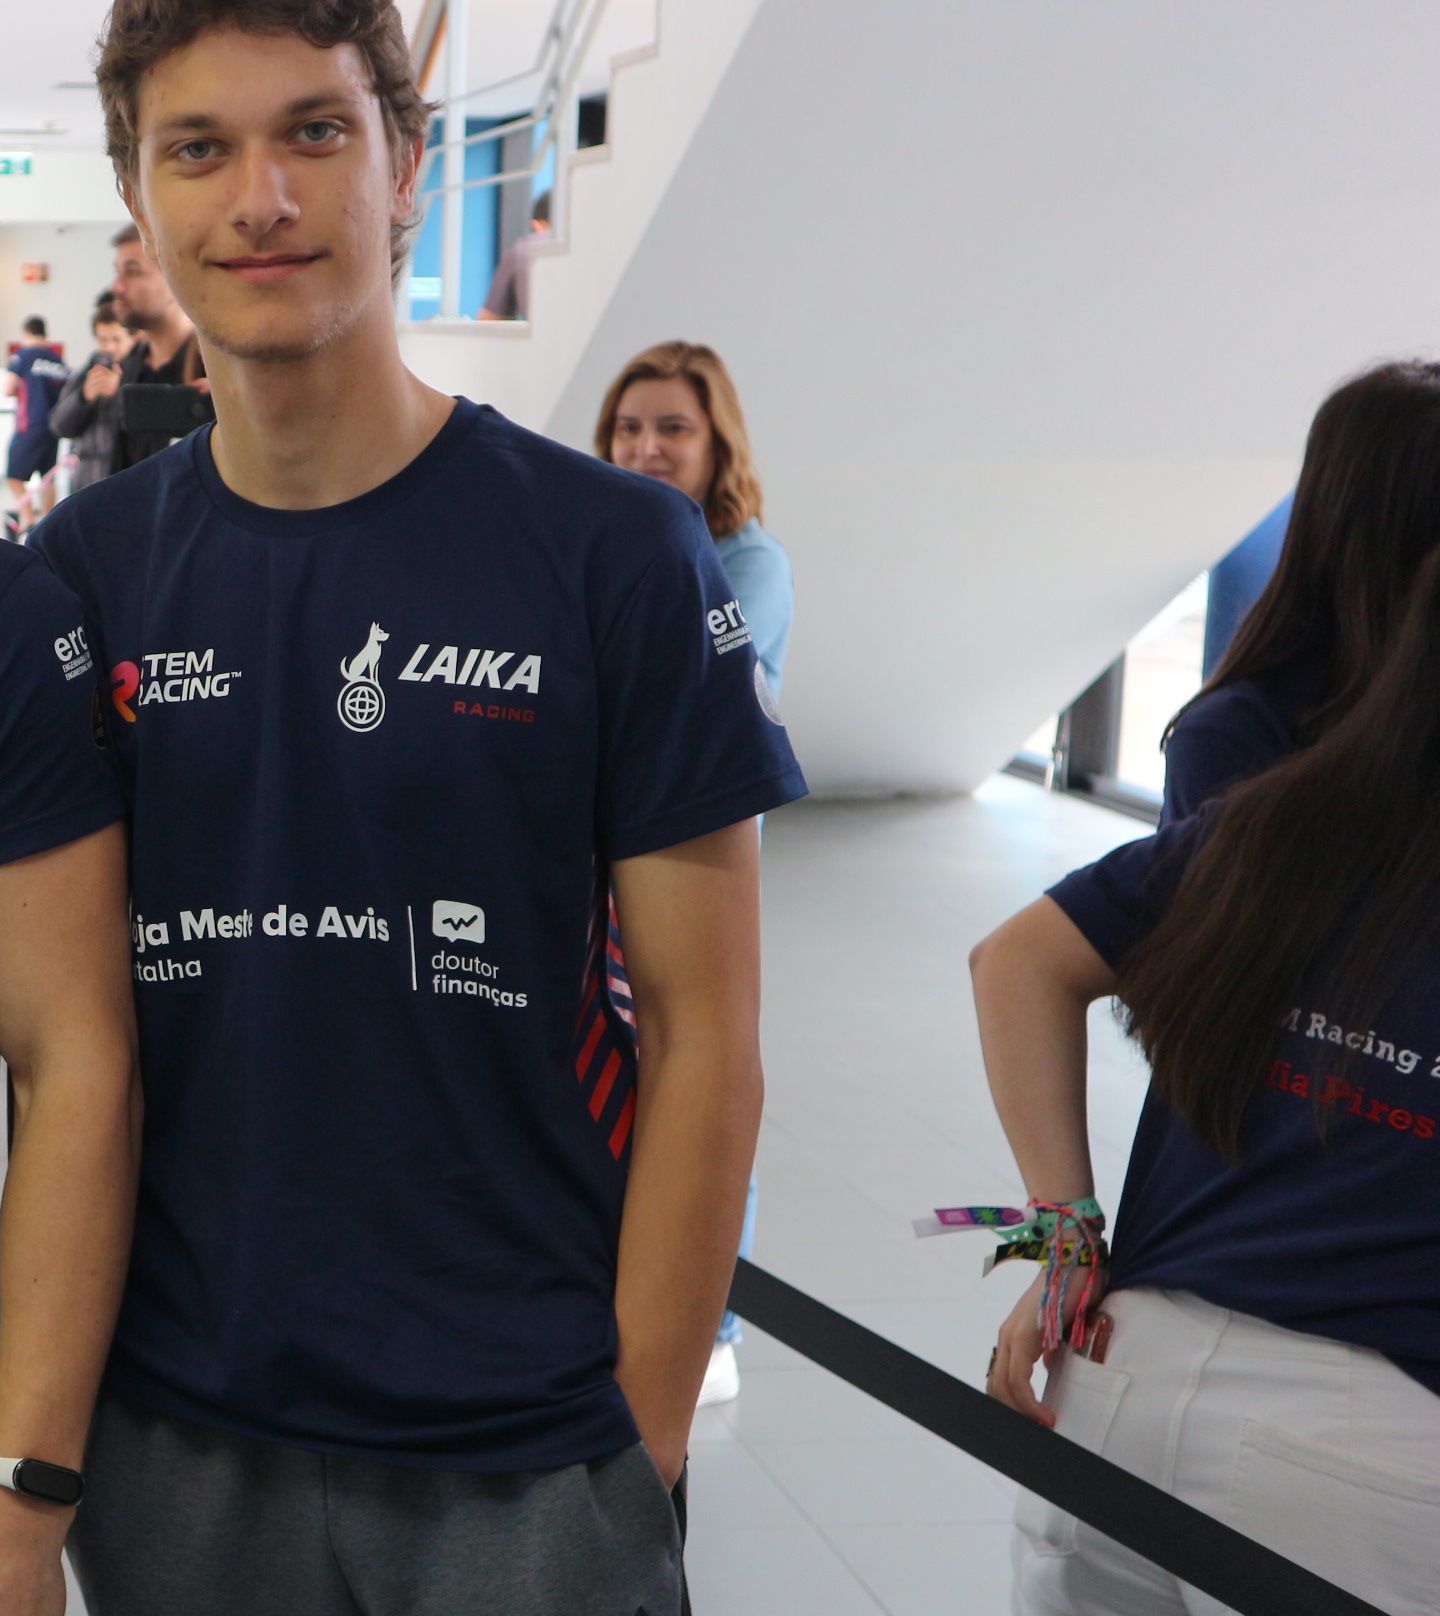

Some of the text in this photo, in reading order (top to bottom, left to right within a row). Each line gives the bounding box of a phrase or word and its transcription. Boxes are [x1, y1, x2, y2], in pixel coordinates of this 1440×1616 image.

[141, 648, 215, 678] TEM
[398, 643, 542, 694] LAIKA
[454, 700, 535, 722] RACING
[131, 913, 171, 954] oja
[262, 904, 309, 937] de
[316, 906, 391, 942] Avis
[133, 957, 203, 983] talha
[431, 950, 500, 980] doutor
[432, 974, 529, 1009] finanças
[1305, 1012, 1423, 1075] Racing
[1319, 1073, 1437, 1139] Pires
